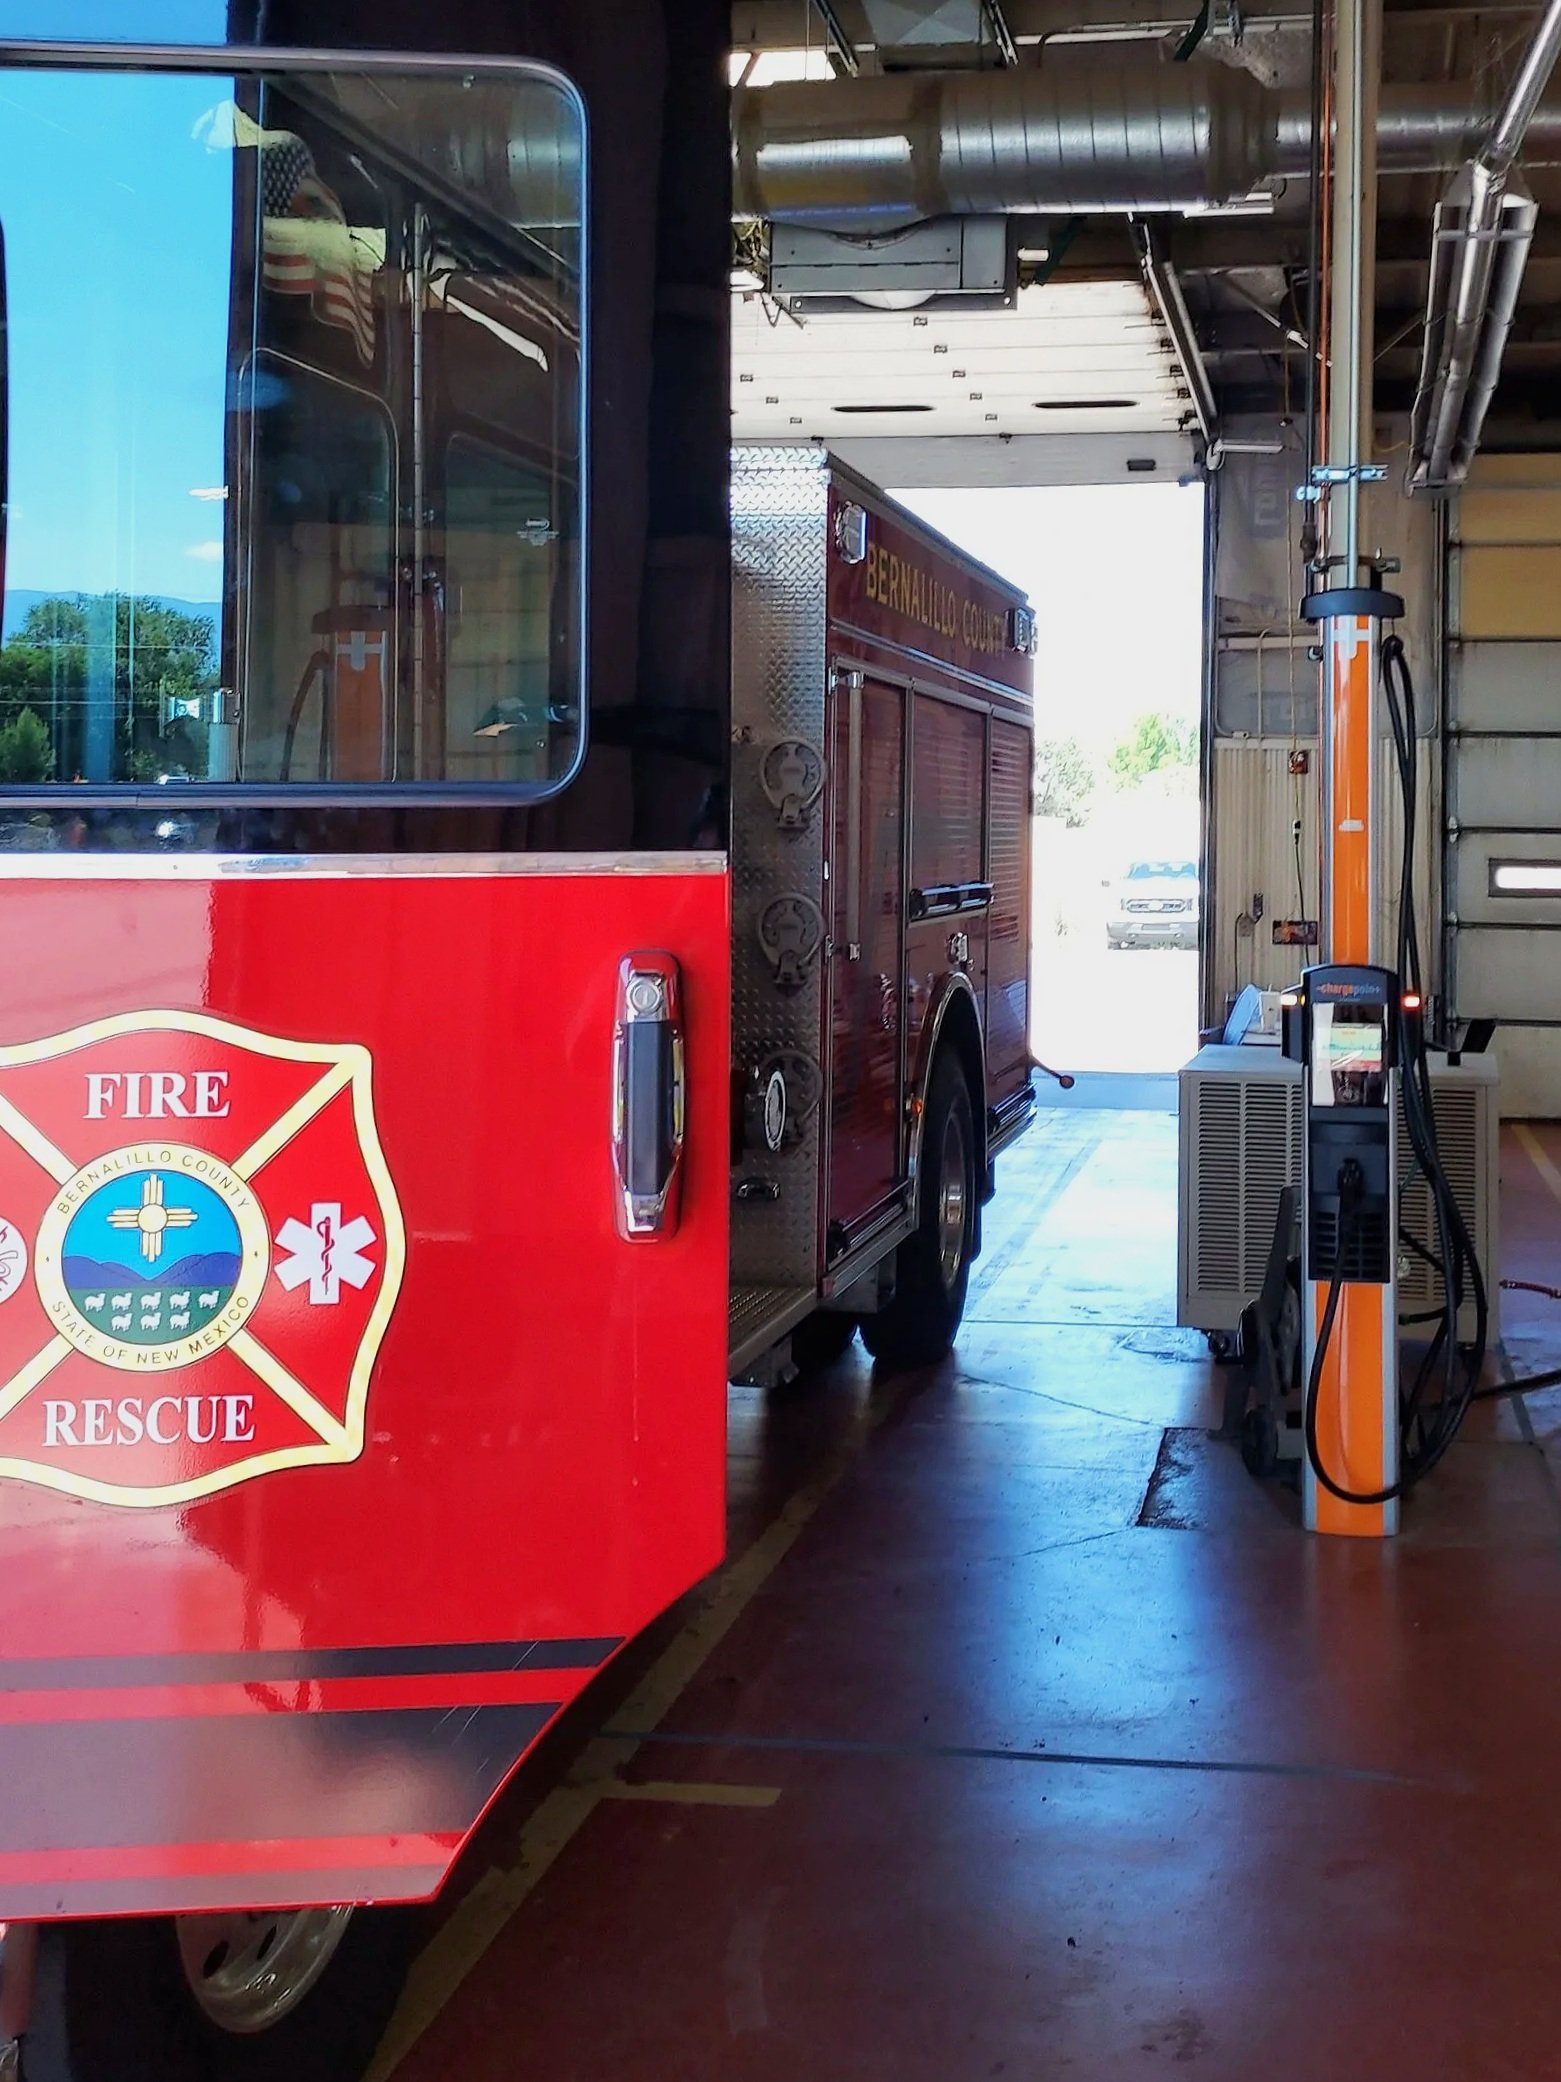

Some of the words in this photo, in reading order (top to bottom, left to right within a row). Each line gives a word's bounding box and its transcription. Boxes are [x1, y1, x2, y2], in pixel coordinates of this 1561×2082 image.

[866, 541, 956, 639] BERNALILLO
[82, 1071, 231, 1120] FIRE
[57, 1150, 172, 1215] BERNALILLO
[181, 1154, 250, 1209] COUNTY
[52, 1300, 95, 1348] STATE
[102, 1344, 128, 1361] OF
[136, 1348, 180, 1365] NEW
[187, 1295, 249, 1354] MEXICO
[42, 1394, 256, 1448] RESCUE
